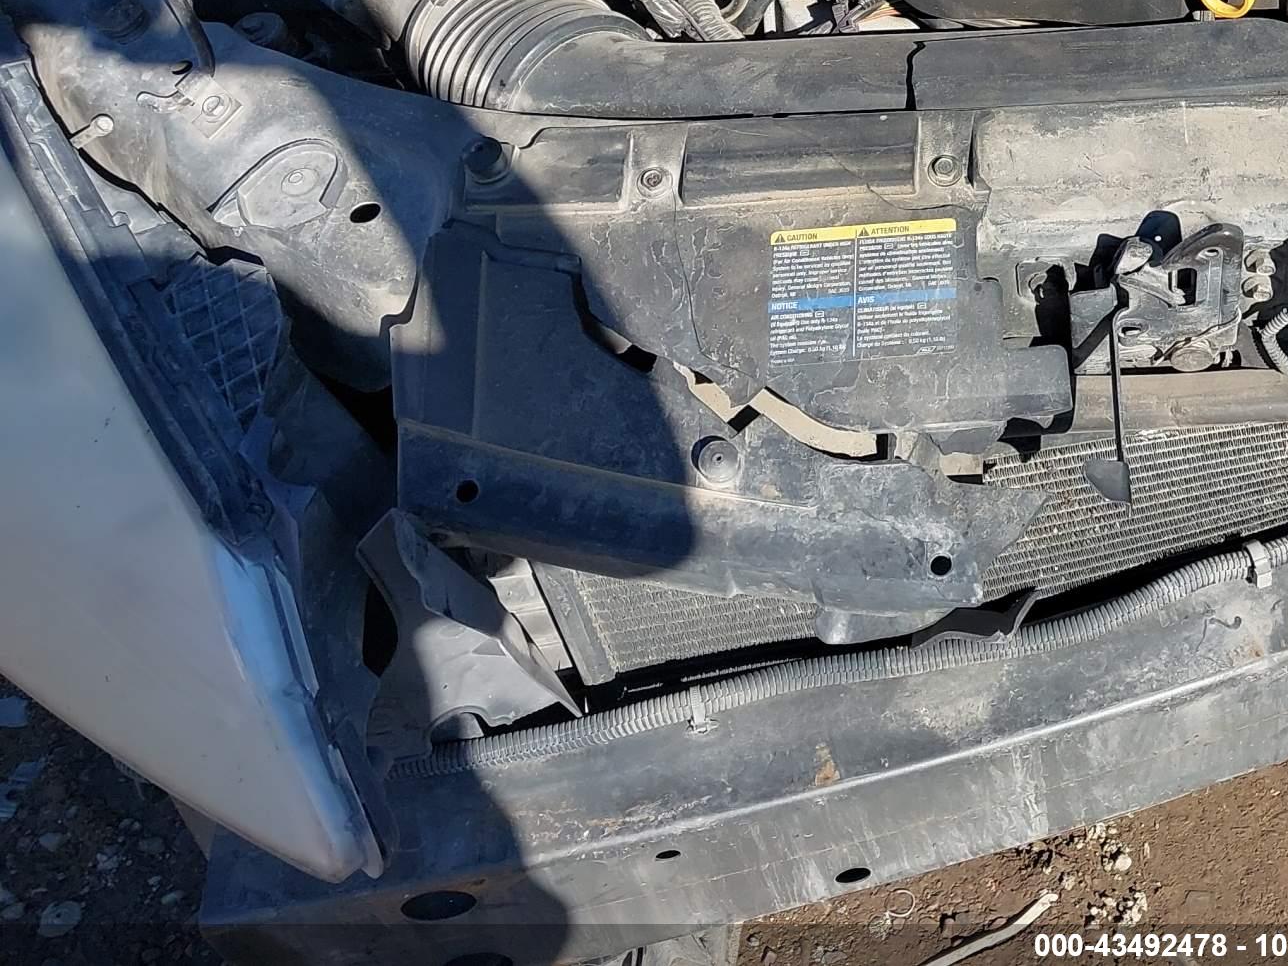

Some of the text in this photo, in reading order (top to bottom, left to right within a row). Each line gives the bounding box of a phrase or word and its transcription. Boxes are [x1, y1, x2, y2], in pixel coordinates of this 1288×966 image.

[871, 226, 910, 235] ATTENTION
[786, 233, 818, 241] CAUTION
[858, 296, 875, 304] AVIS
[772, 302, 798, 310] NOTICE
